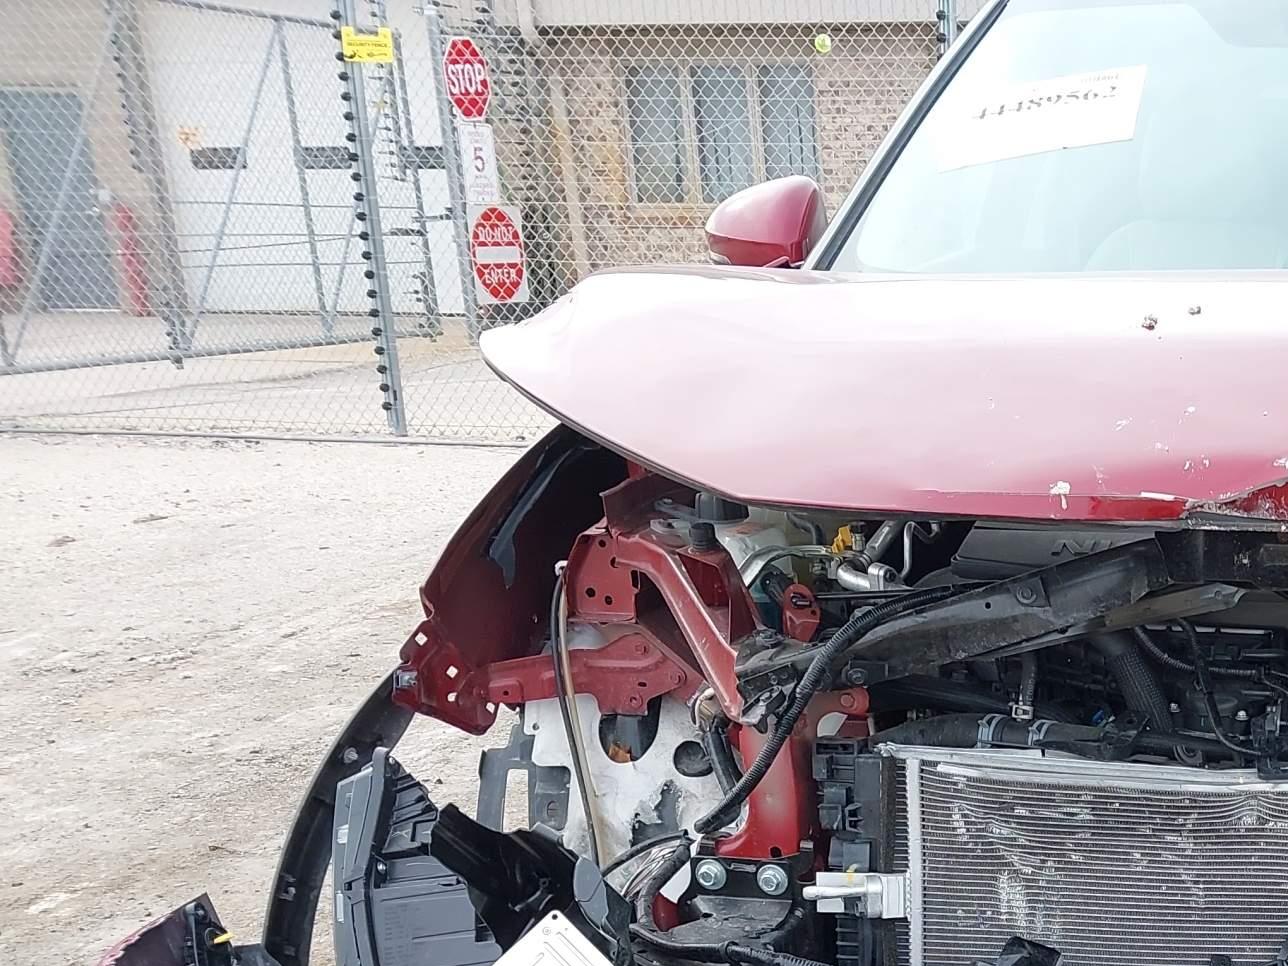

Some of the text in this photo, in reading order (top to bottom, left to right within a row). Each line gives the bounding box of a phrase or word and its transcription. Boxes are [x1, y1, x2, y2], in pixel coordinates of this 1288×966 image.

[447, 63, 485, 95] STOP
[473, 146, 486, 173] 5
[479, 226, 513, 241] DO NOT
[484, 267, 517, 284] ENTER
